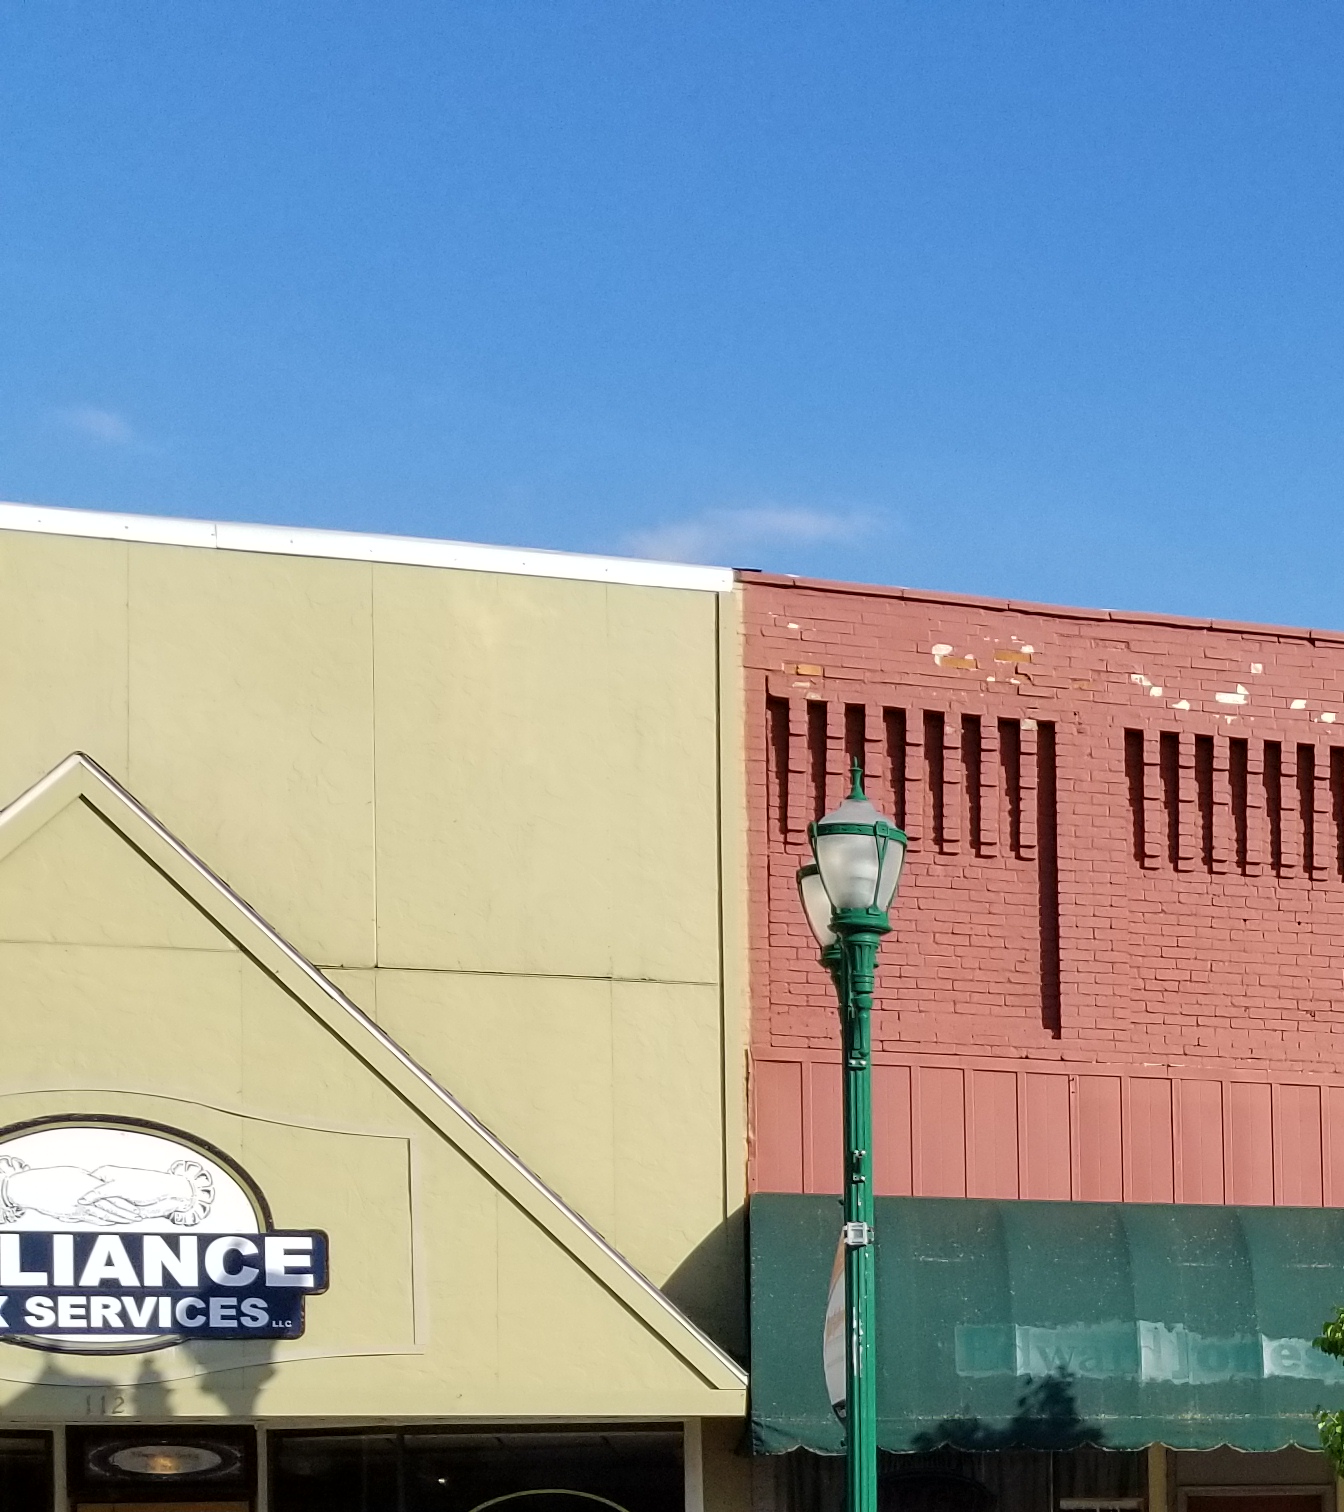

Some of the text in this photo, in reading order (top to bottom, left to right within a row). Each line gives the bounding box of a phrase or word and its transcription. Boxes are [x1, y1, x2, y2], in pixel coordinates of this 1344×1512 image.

[24, 1296, 270, 1329] SERVICES
[272, 1320, 293, 1329] LLC
[85, 1395, 125, 1415] 112
